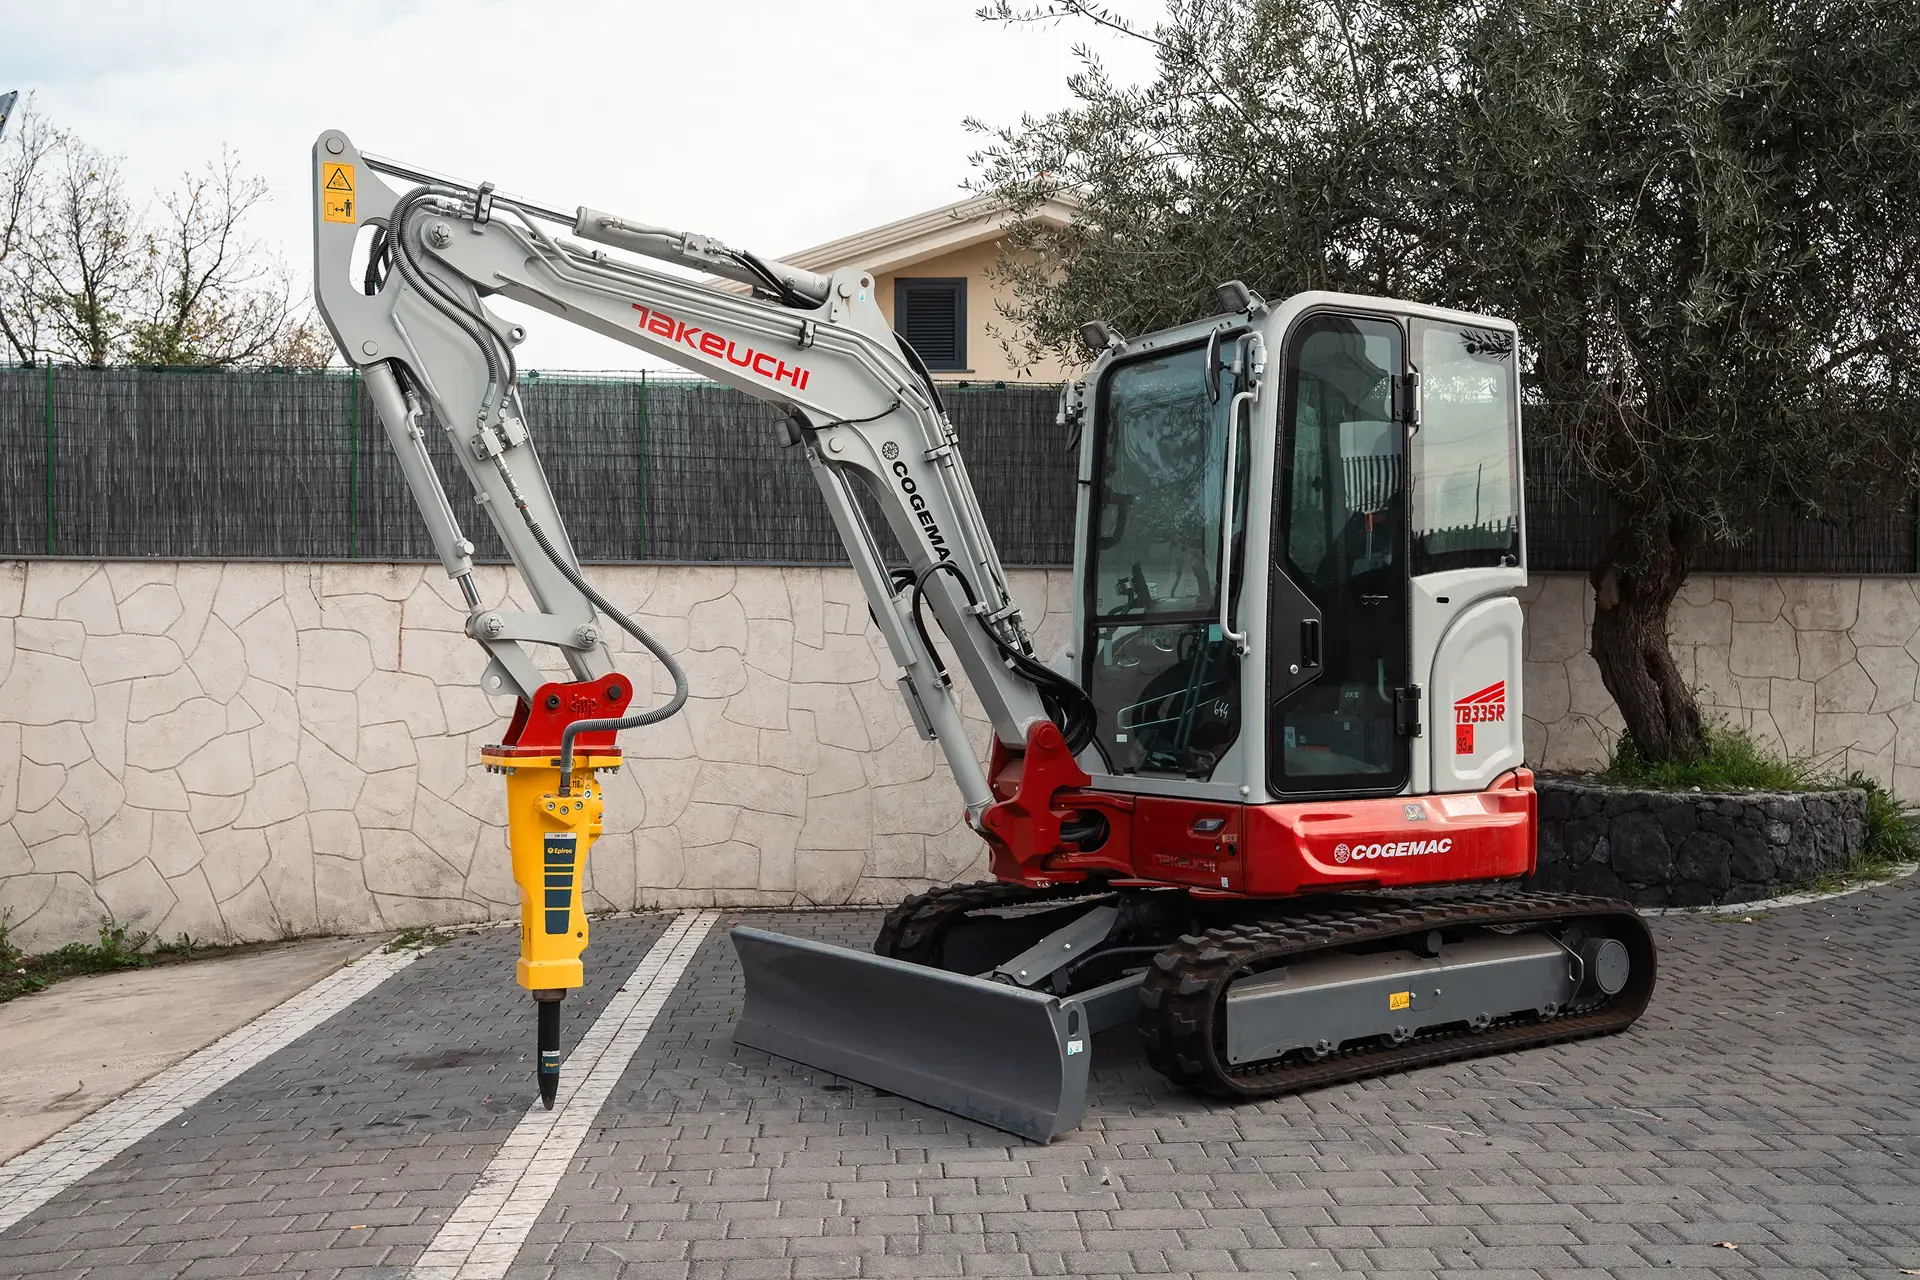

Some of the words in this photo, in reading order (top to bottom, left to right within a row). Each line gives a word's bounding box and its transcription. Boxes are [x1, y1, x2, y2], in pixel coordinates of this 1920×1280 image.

[1213, 699, 1229, 719] 644
[1453, 704, 1506, 724] TB335R
[1457, 737, 1468, 752] 93
[572, 780, 581, 789] 118
[554, 847, 573, 855] Epiroc
[1351, 838, 1453, 860] COGEMAC
